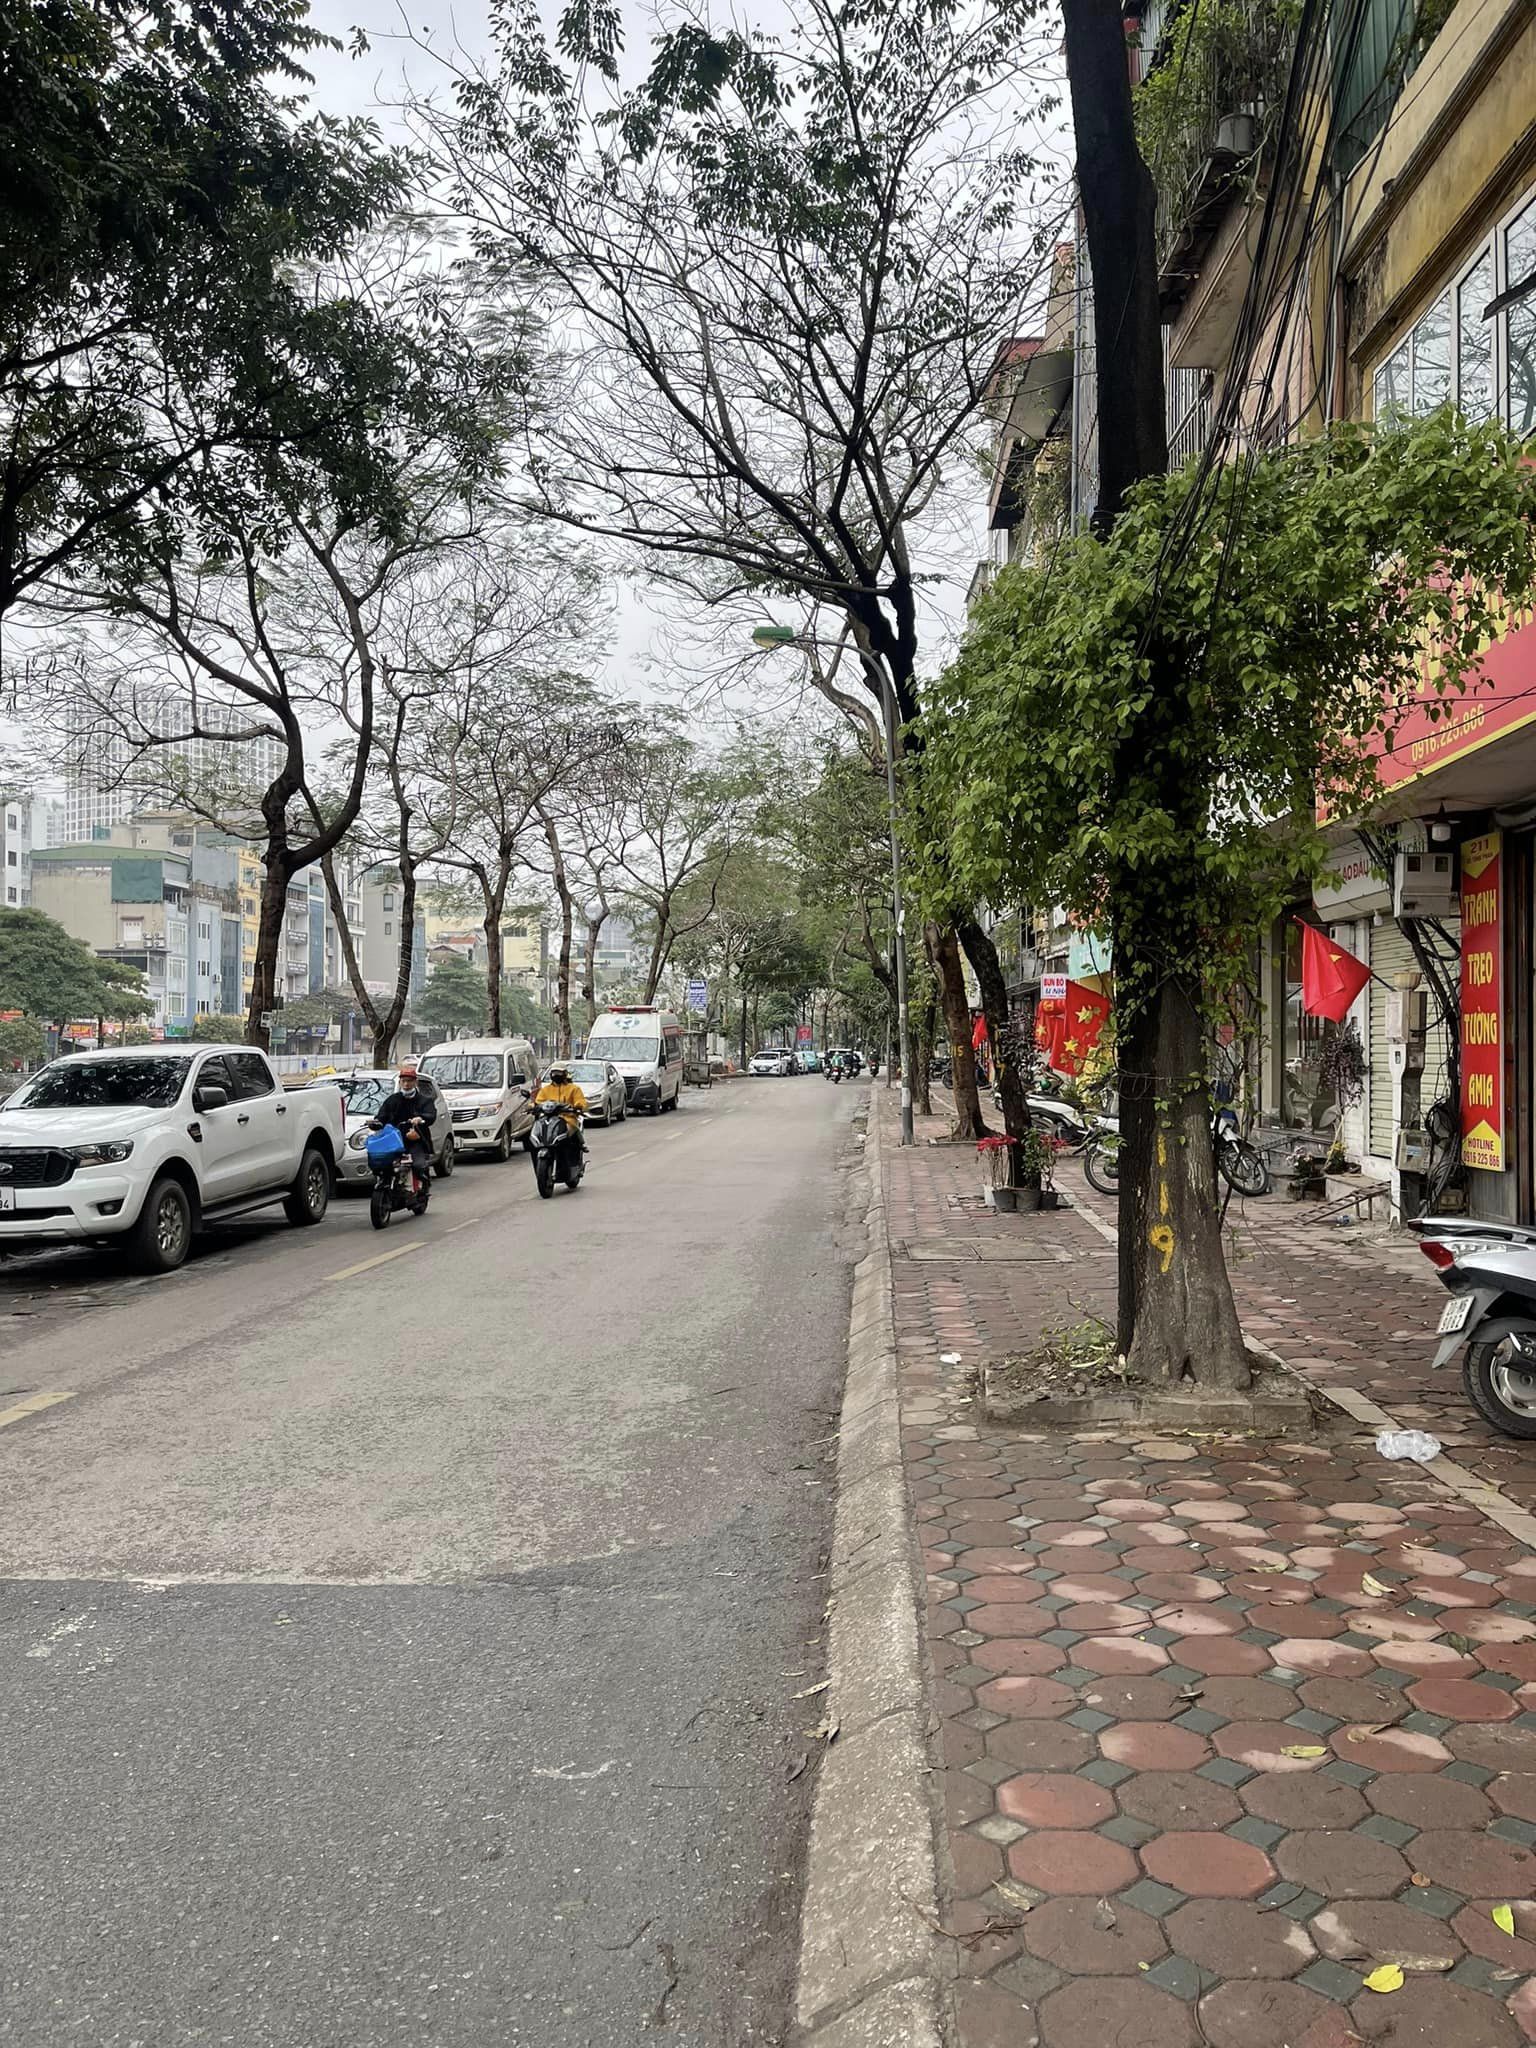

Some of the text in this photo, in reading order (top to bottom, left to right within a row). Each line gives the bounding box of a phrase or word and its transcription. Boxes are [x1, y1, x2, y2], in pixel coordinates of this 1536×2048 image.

[1411, 703, 1485, 762] 0916.225.866
[1471, 839, 1489, 853] 211
[1464, 888, 1496, 928] TRANH
[1468, 951, 1493, 987] TREO
[1468, 1074, 1493, 1109] AMIA
[1468, 1138, 1494, 1151] HOTLINE
[1478, 1153, 1488, 1165] 225
